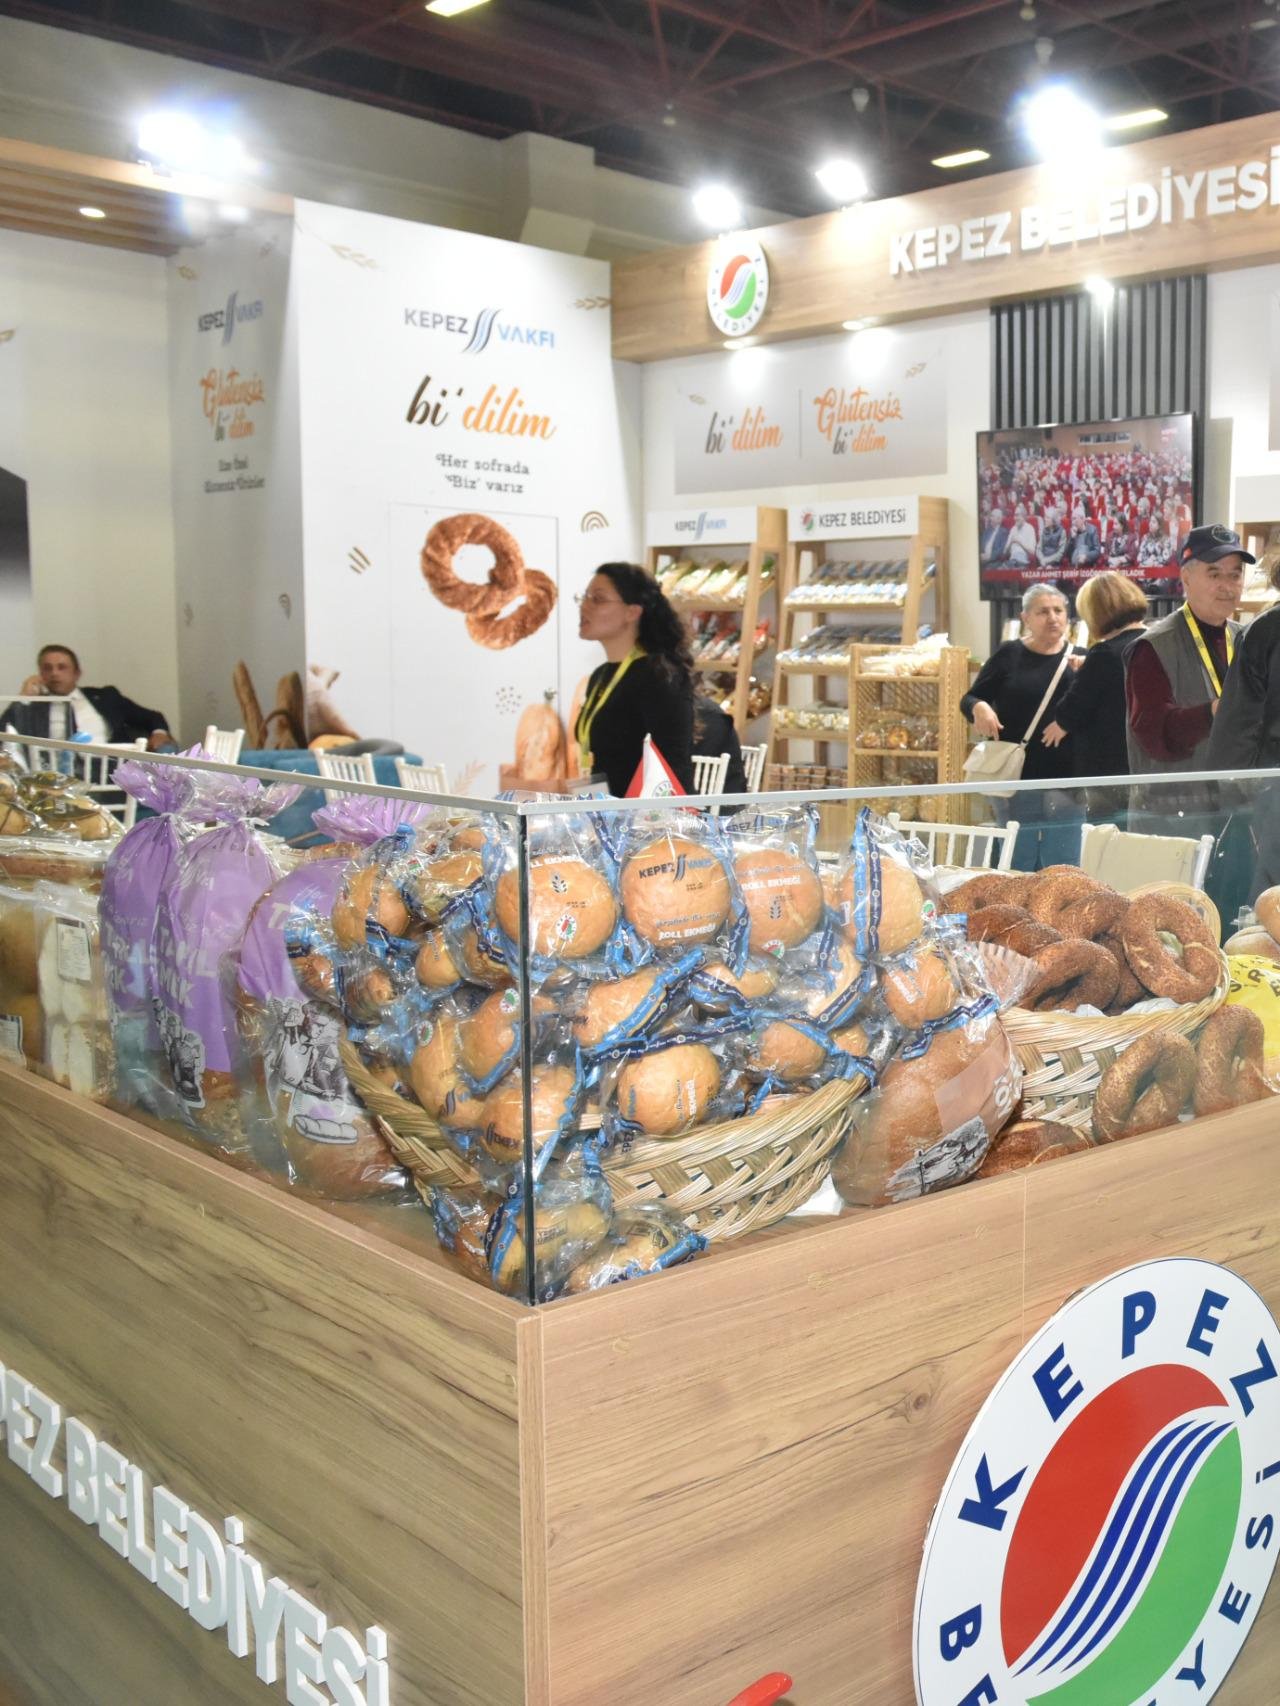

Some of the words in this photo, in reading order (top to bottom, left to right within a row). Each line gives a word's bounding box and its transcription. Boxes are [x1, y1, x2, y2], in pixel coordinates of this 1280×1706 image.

[889, 211, 1012, 276] KEPEZ
[403, 307, 469, 335] KEPEZ
[497, 323, 557, 349] VAKFI
[462, 383, 558, 441] dilim
[731, 404, 784, 452] dilim
[811, 386, 904, 441] Glutensiz
[852, 421, 889, 453] dilim
[474, 456, 530, 476] sofrada
[486, 479, 524, 494] varız
[674, 520, 697, 532] KEPEZ
[818, 512, 847, 528] KEPEZ
[850, 508, 907, 527] BELEDİYESİ
[638, 861, 676, 879] KEPEZ
[658, 929, 682, 941] ROLL
[957, 1288, 1278, 1532] KEPEZ
[65, 1416, 390, 1706] BELEDİYESİ
